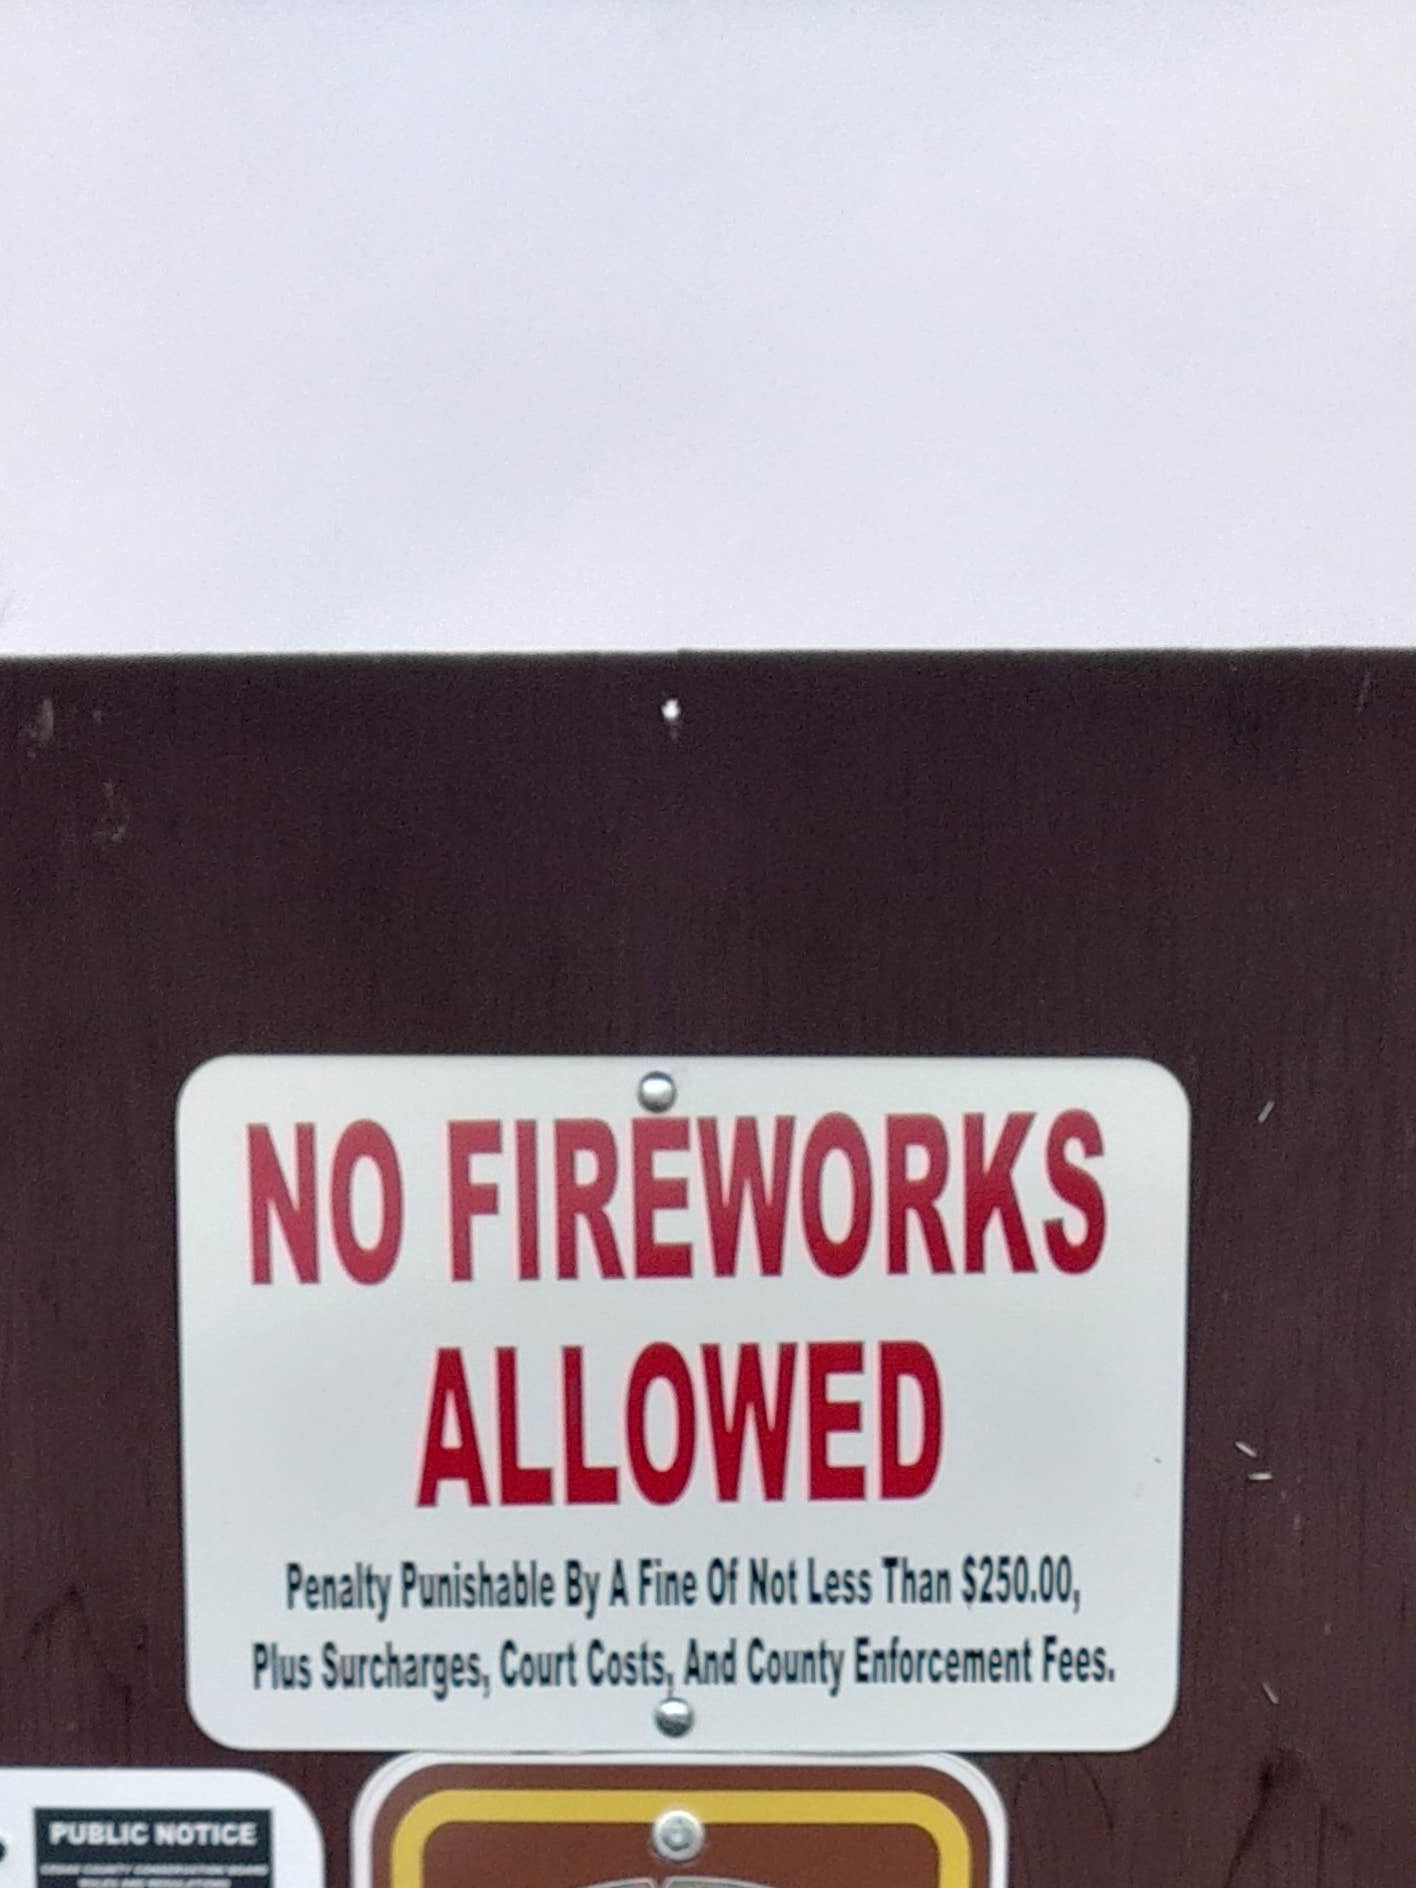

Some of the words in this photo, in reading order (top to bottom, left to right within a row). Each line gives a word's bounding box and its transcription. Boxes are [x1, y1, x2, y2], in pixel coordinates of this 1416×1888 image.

[246, 1118, 405, 1286] NO
[446, 1107, 1109, 1283] FIREWORKS
[415, 1340, 945, 1508] ALLOWED
[285, 1561, 393, 1622] Penalty
[400, 1560, 557, 1609] Punishable
[564, 1558, 601, 1620] By
[609, 1557, 630, 1607] A
[637, 1556, 698, 1607] Fine
[706, 1556, 741, 1605] Of
[748, 1556, 798, 1606] Not
[806, 1556, 873, 1606] Less
[880, 1555, 952, 1604] Than
[961, 1553, 1082, 1615] $250.00,
[251, 1641, 313, 1690] Plus
[320, 1640, 491, 1701] Surcharges,
[499, 1638, 578, 1689] Court
[586, 1637, 675, 1698] Costs,
[682, 1636, 737, 1686] And
[745, 1636, 846, 1698] County
[852, 1634, 1034, 1685] Enforcement
[1041, 1633, 1116, 1684] Fees.
[48, 1821, 150, 1847] PUBLIC
[153, 1821, 259, 1847] NOTICE
